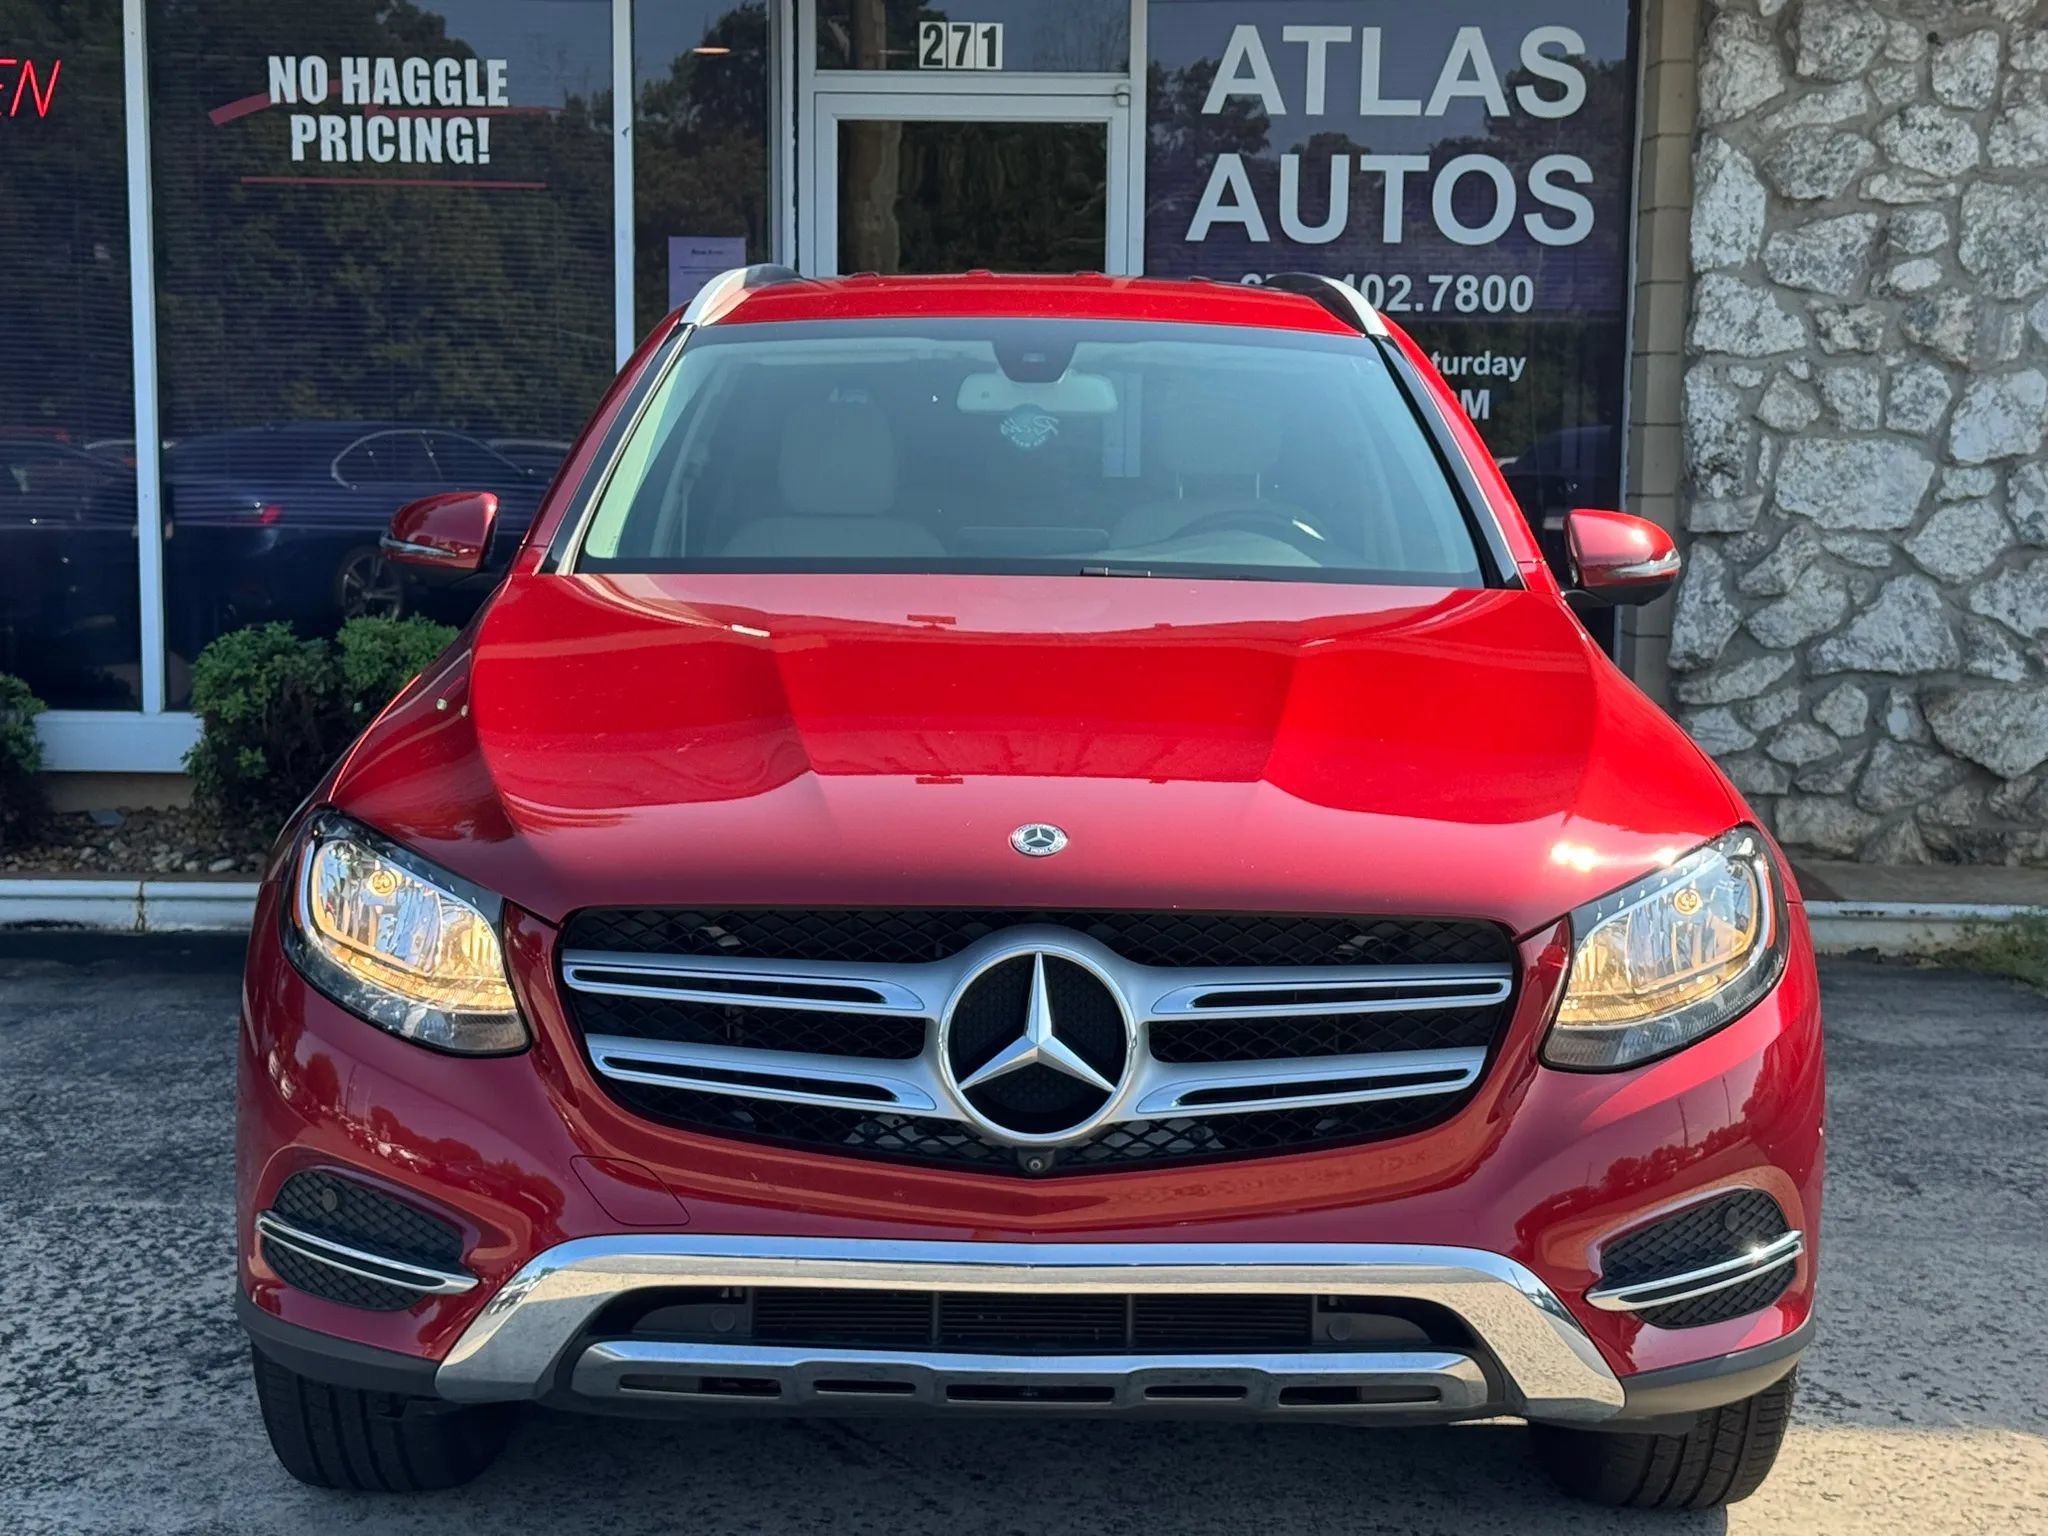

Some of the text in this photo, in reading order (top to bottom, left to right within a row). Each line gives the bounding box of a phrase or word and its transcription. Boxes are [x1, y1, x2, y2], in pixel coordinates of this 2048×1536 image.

[922, 23, 997, 67] 271
[269, 55, 509, 106] NO HAGGLE
[1201, 25, 1586, 118] ATLAS
[290, 114, 490, 164] PRICING!
[1185, 153, 1595, 246] AUTOS
[1431, 350, 1526, 382] turday
[1452, 388, 1490, 419] M
